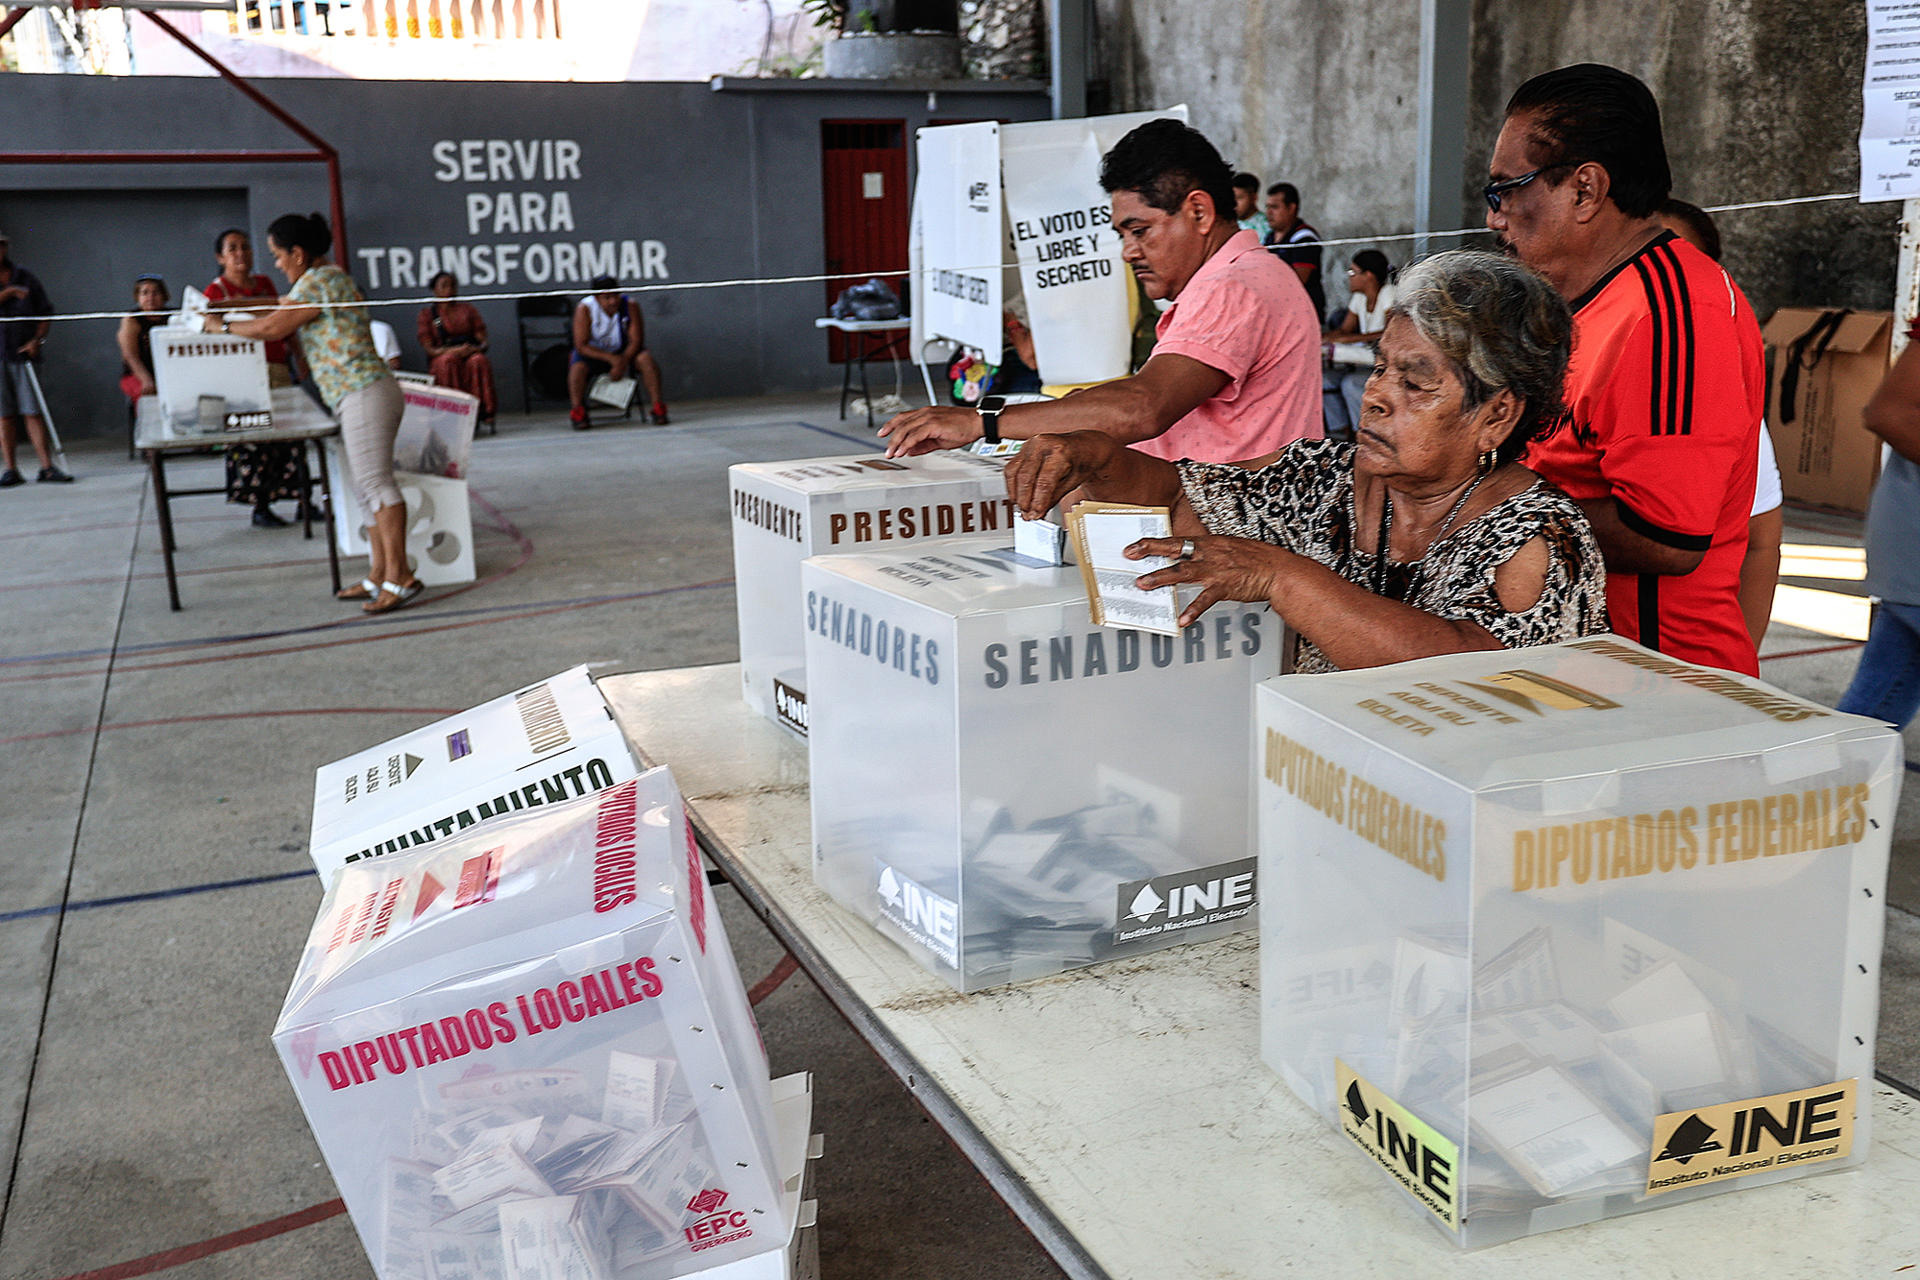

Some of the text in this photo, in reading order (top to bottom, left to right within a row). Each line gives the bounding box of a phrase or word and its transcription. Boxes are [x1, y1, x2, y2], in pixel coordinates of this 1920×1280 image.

[432, 139, 581, 182] SERVIR
[466, 191, 575, 234] PARA
[1016, 205, 1112, 241] EL VOTO ES
[357, 239, 669, 289] TRANSFORMAR
[1035, 259, 1112, 289] SECRETO
[1036, 237, 1085, 263] LIBRE
[1088, 233, 1100, 253] Y
[168, 342, 255, 357] PRESIDENTE
[733, 488, 802, 543] PRESIDENTE
[830, 499, 1016, 545] PRESIDENT
[807, 589, 939, 686] SENADORES
[983, 611, 1263, 690] SENADORES
[1356, 698, 1436, 737] BOLETA
[1265, 726, 1346, 825] DIPUTADOS
[346, 758, 614, 864] UNTAMIENTO
[1348, 774, 1446, 883] FEDERALES
[1706, 782, 1869, 866] FEDERALES
[1512, 806, 1698, 892] DIPUTADOS
[593, 843, 637, 914] LOCALES
[1168, 872, 1253, 919] INE
[903, 881, 958, 949] INE
[1120, 925, 1163, 941] Instituto
[1163, 914, 1208, 932] Nacional
[516, 956, 664, 1037] LOCALES
[318, 1001, 518, 1091] DIPUTADOS
[1728, 1090, 1845, 1158] INE
[1375, 1108, 1452, 1205] INE
[1649, 1144, 1839, 1190] Instituto Nacional Electoral
[684, 1211, 747, 1242] IEPC
[691, 1229, 753, 1252] GUERRERO
